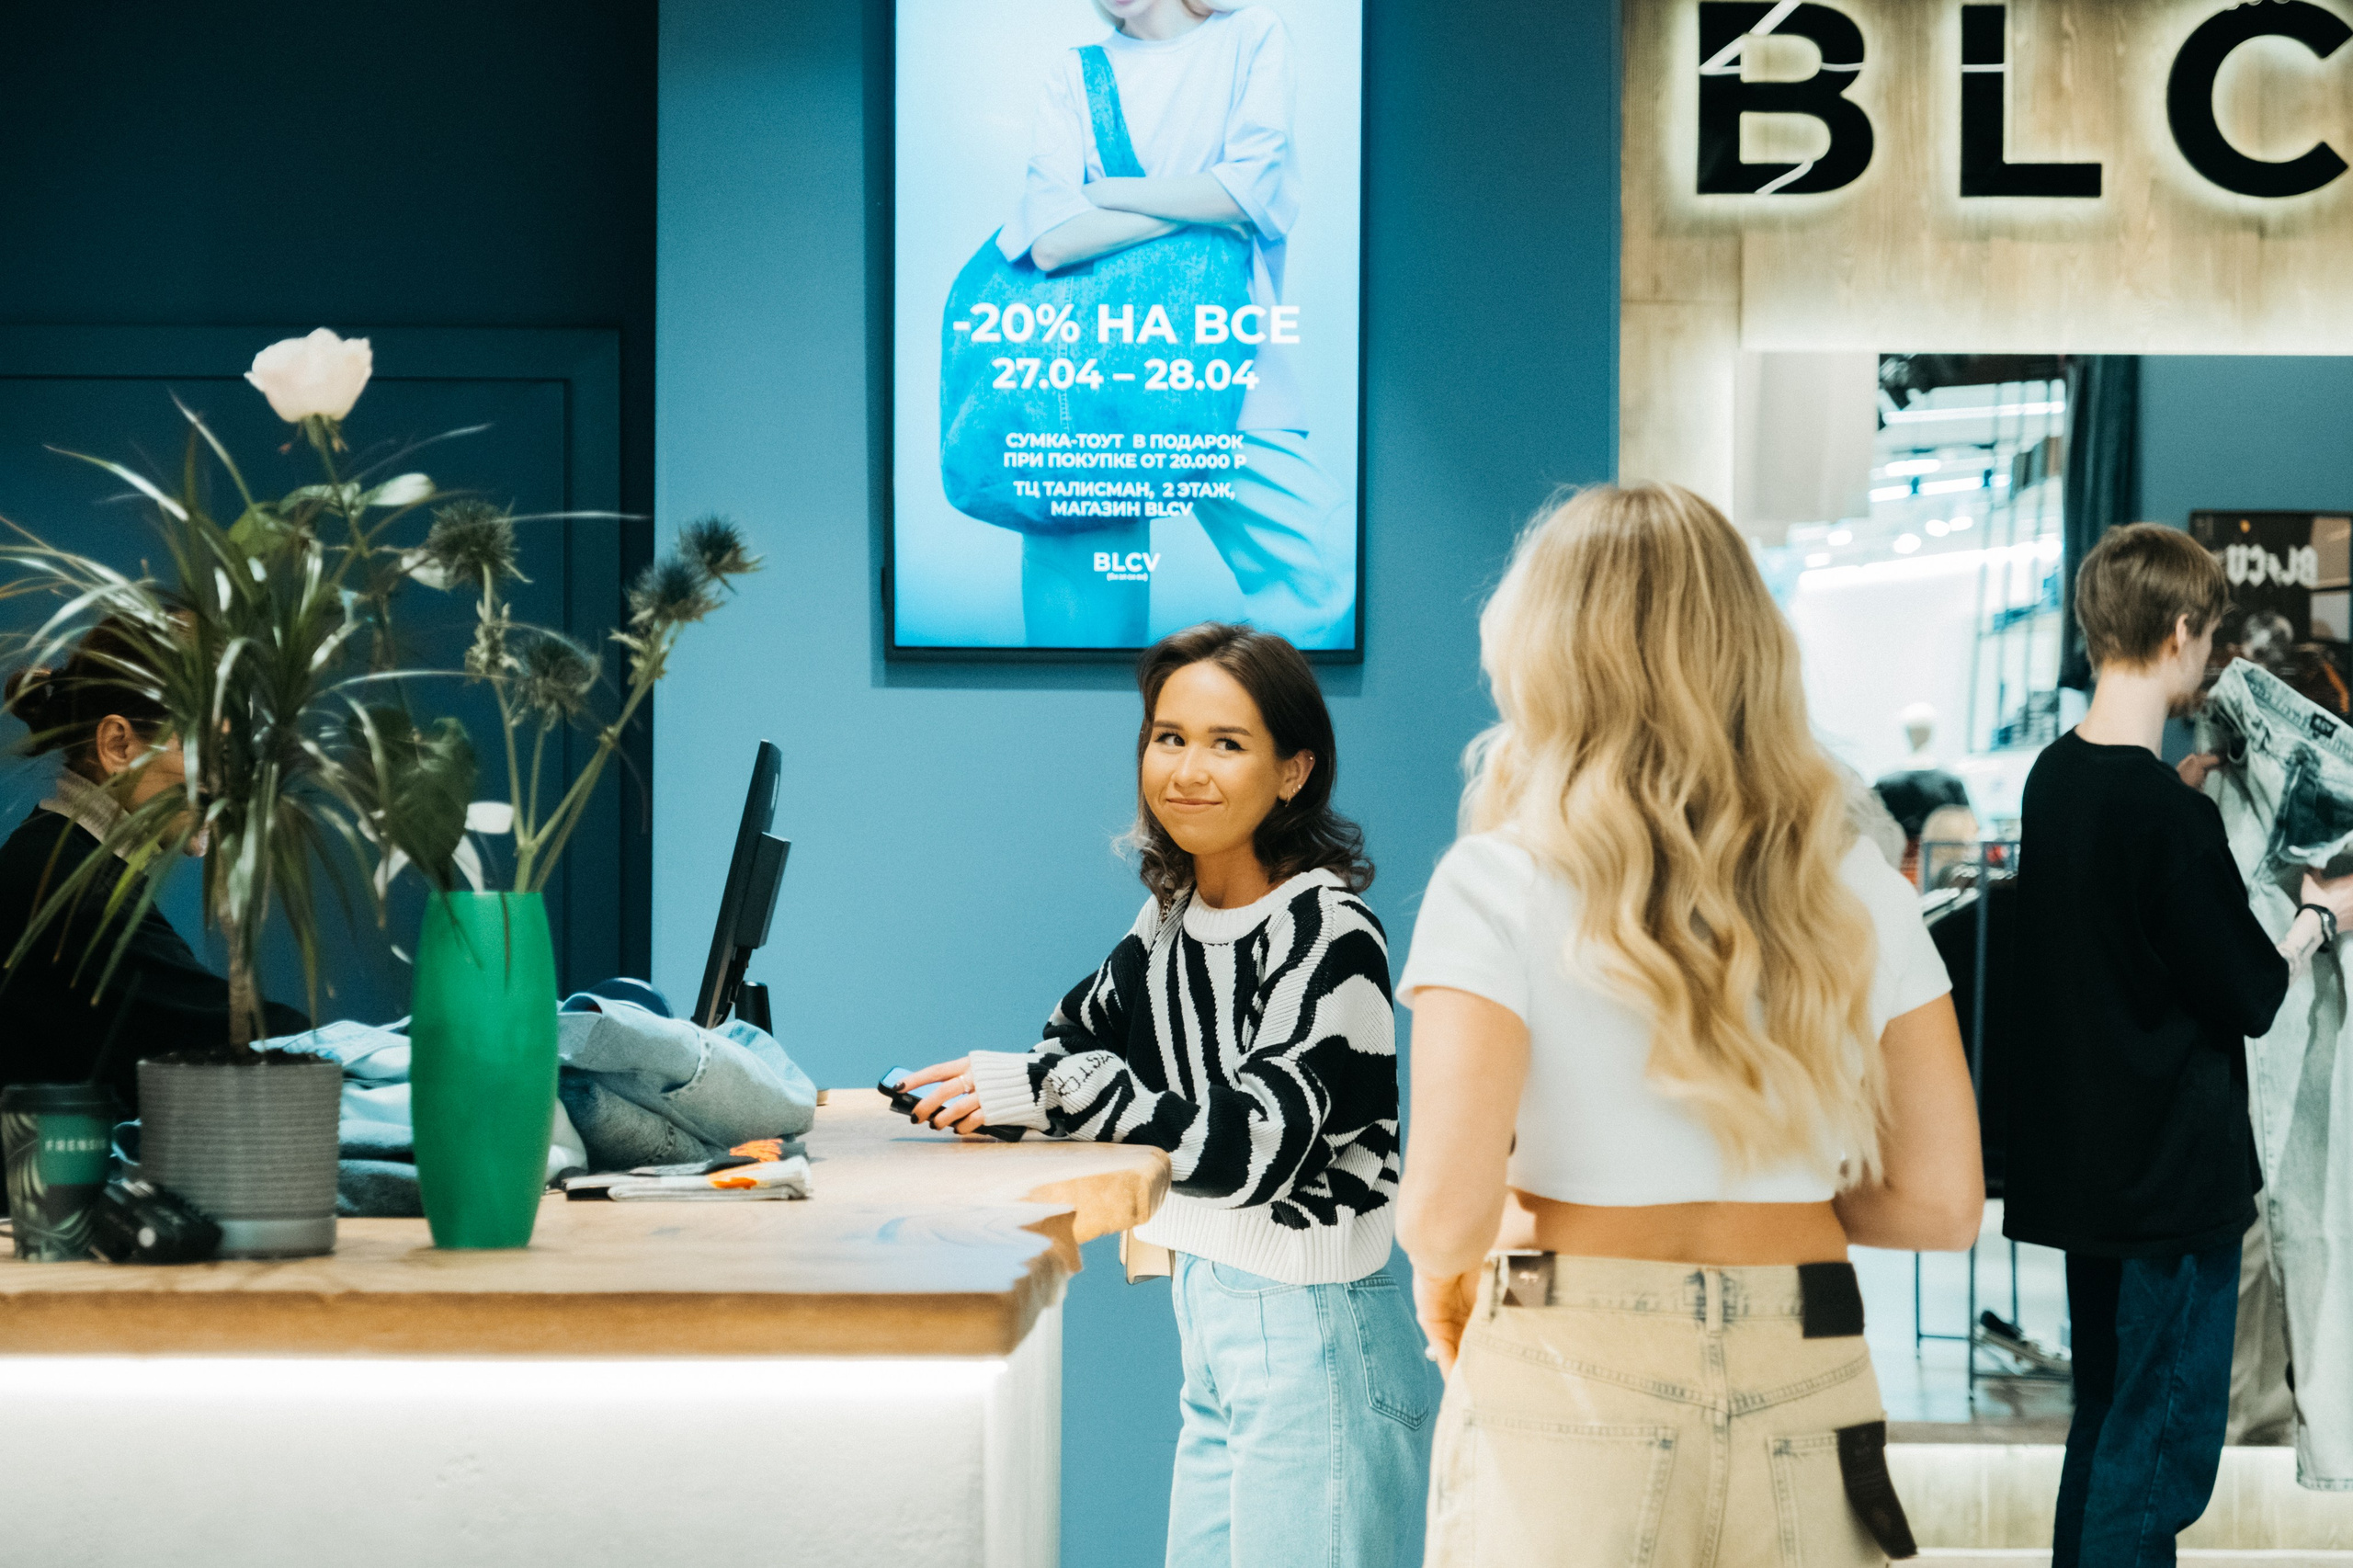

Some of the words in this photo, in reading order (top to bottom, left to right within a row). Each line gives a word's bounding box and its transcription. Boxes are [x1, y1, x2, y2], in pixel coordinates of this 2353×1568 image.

[952, 302, 1081, 344] -20%
[1097, 303, 1179, 345] НА
[1195, 304, 1302, 346] ВСЕ
[992, 357, 1105, 390] 27.04
[1143, 358, 1260, 391] 28.04
[1006, 433, 1124, 449] СУМКА-ТОУТ
[1132, 434, 1146, 449] В
[1150, 434, 1245, 453] ПОДАРОК
[1004, 452, 1044, 468] ПРИ
[1048, 452, 1137, 469] ПОКУПКЕ
[1140, 453, 1167, 469] ОТ
[1169, 454, 1231, 470] 20.000
[1013, 481, 1040, 498] ТЦ
[1042, 481, 1155, 500] ТАЛИСМАН,
[1162, 482, 1176, 498] 2
[1177, 483, 1236, 501] ЭТАЖ,
[1051, 501, 1141, 517] МАГАЗИН
[1144, 502, 1195, 517] BLCV
[1093, 552, 1162, 573] BLCV
